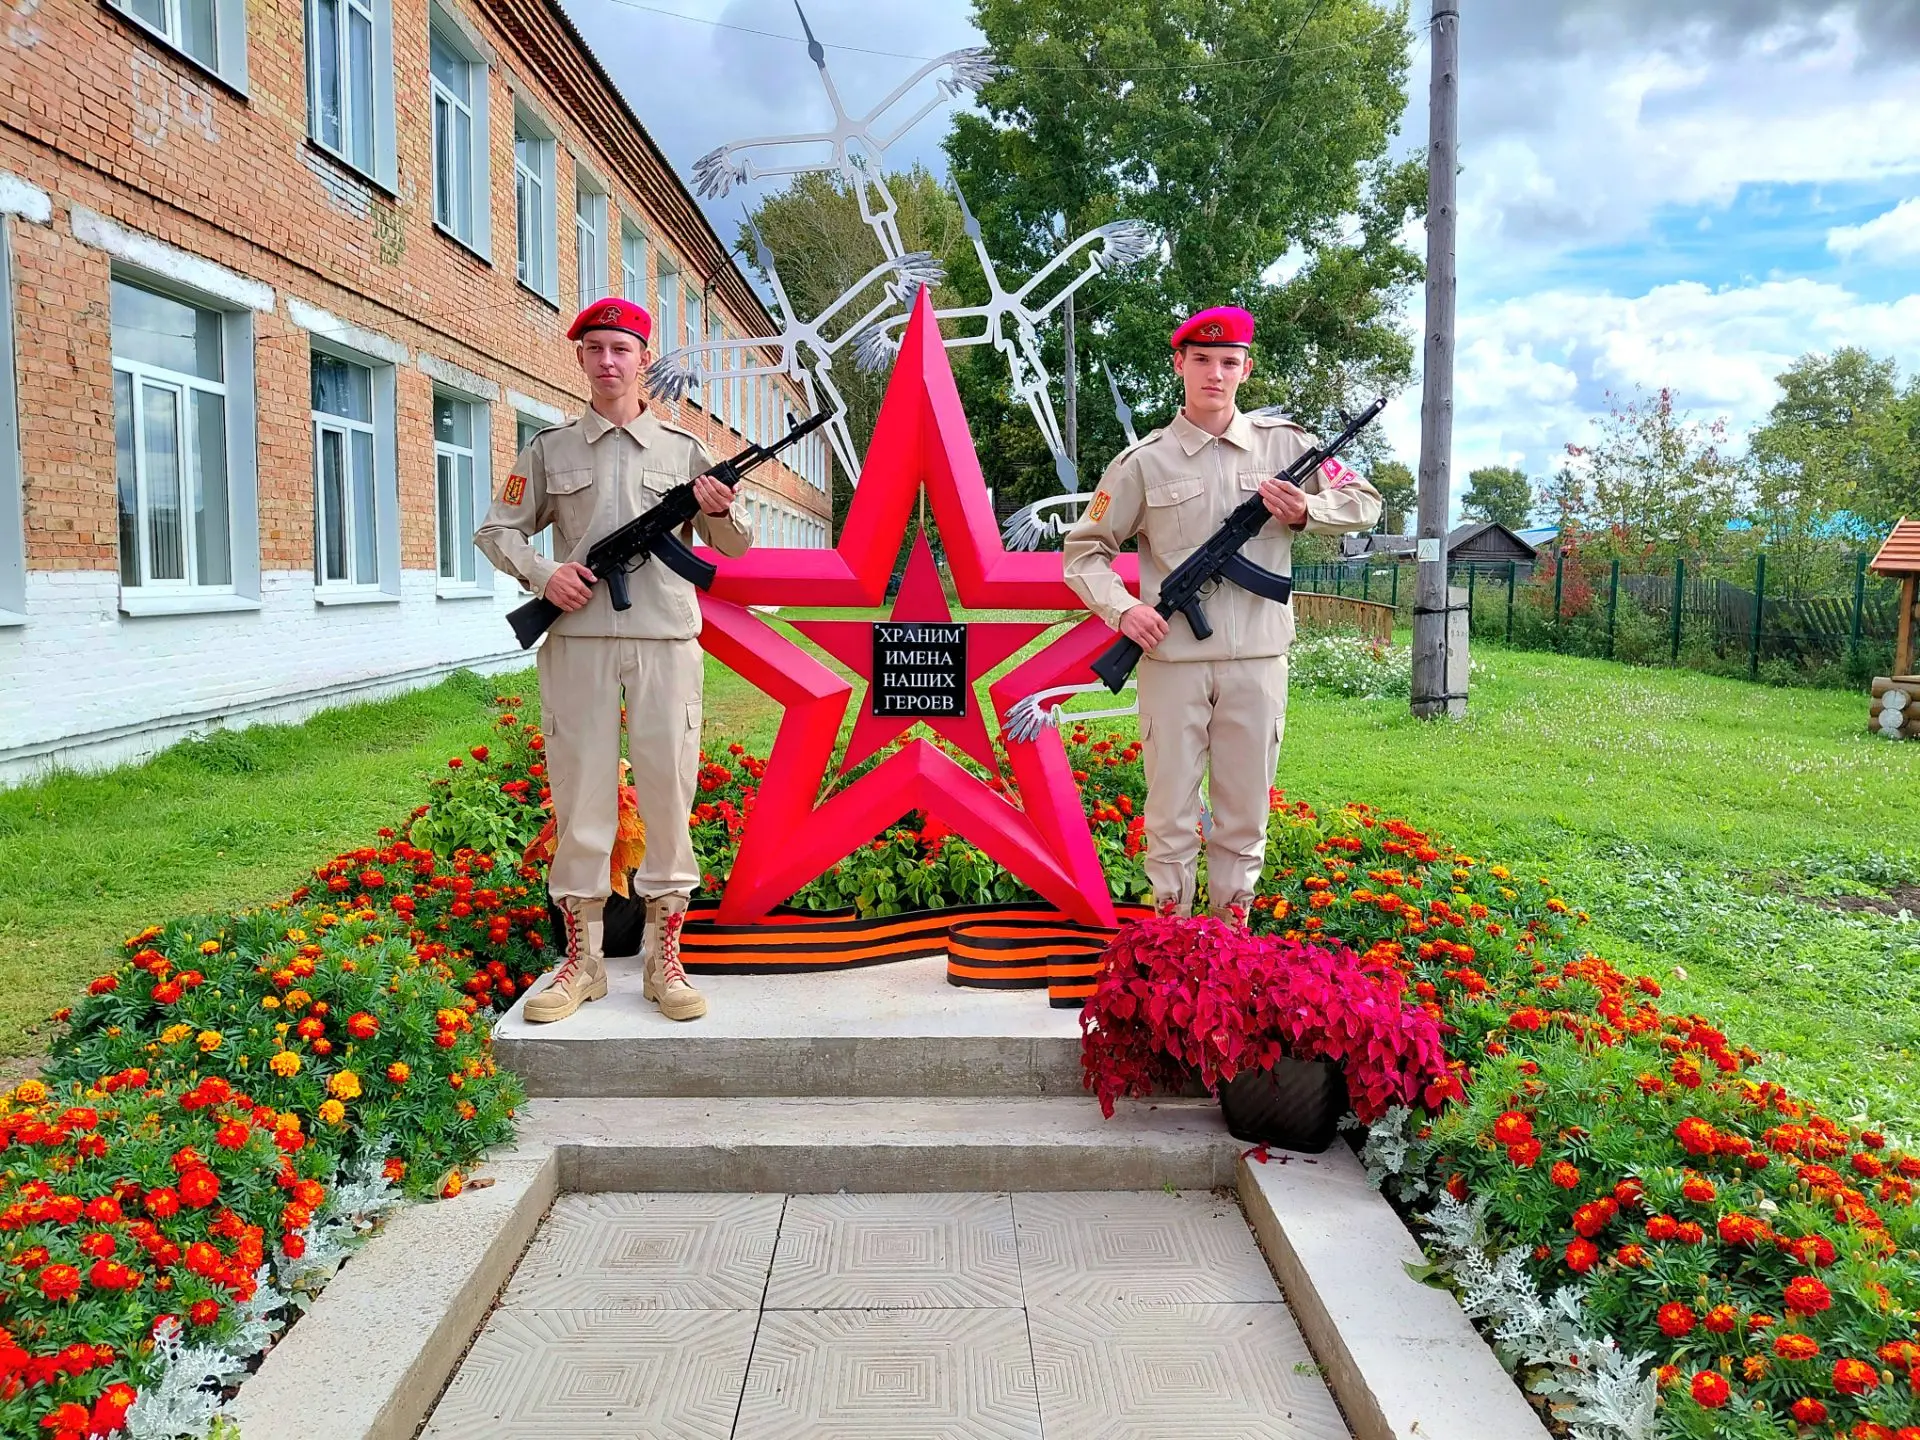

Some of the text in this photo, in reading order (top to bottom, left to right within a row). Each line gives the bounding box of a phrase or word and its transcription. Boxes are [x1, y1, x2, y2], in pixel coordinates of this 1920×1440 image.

[879, 628, 960, 643] ХРАНИМ
[884, 650, 953, 665] ИМЕНА
[883, 672, 956, 687] НАШИХ
[884, 694, 954, 709] ГЕРОЕВ
